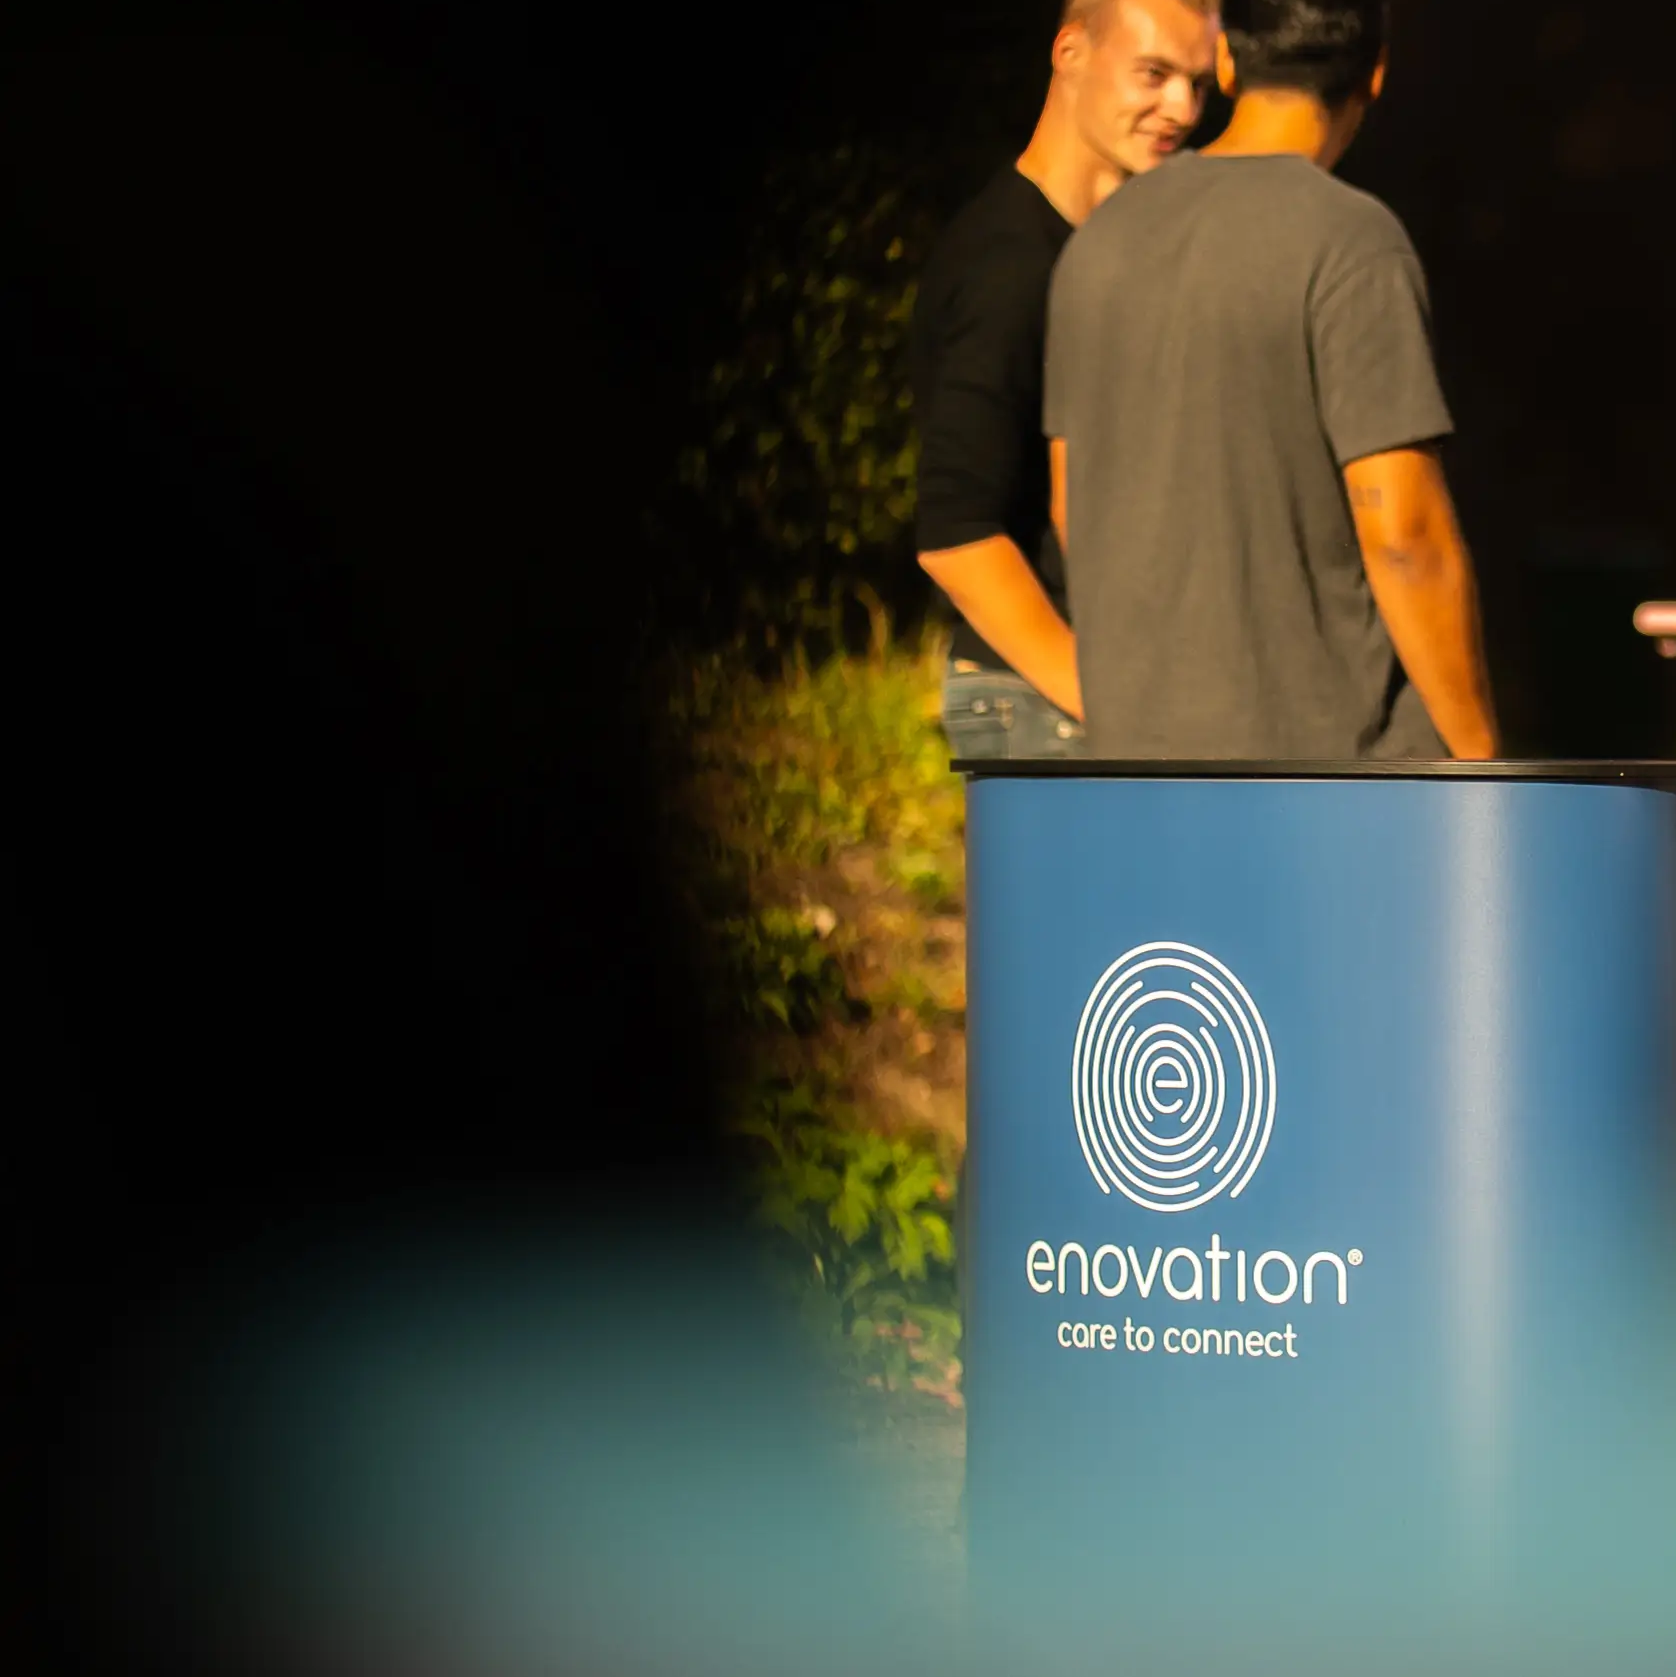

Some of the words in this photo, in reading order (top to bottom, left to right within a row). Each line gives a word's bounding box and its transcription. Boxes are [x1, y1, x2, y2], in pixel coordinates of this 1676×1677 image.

[1057, 1321, 1117, 1350] care
[1123, 1317, 1155, 1352] to
[1163, 1323, 1299, 1358] connect
